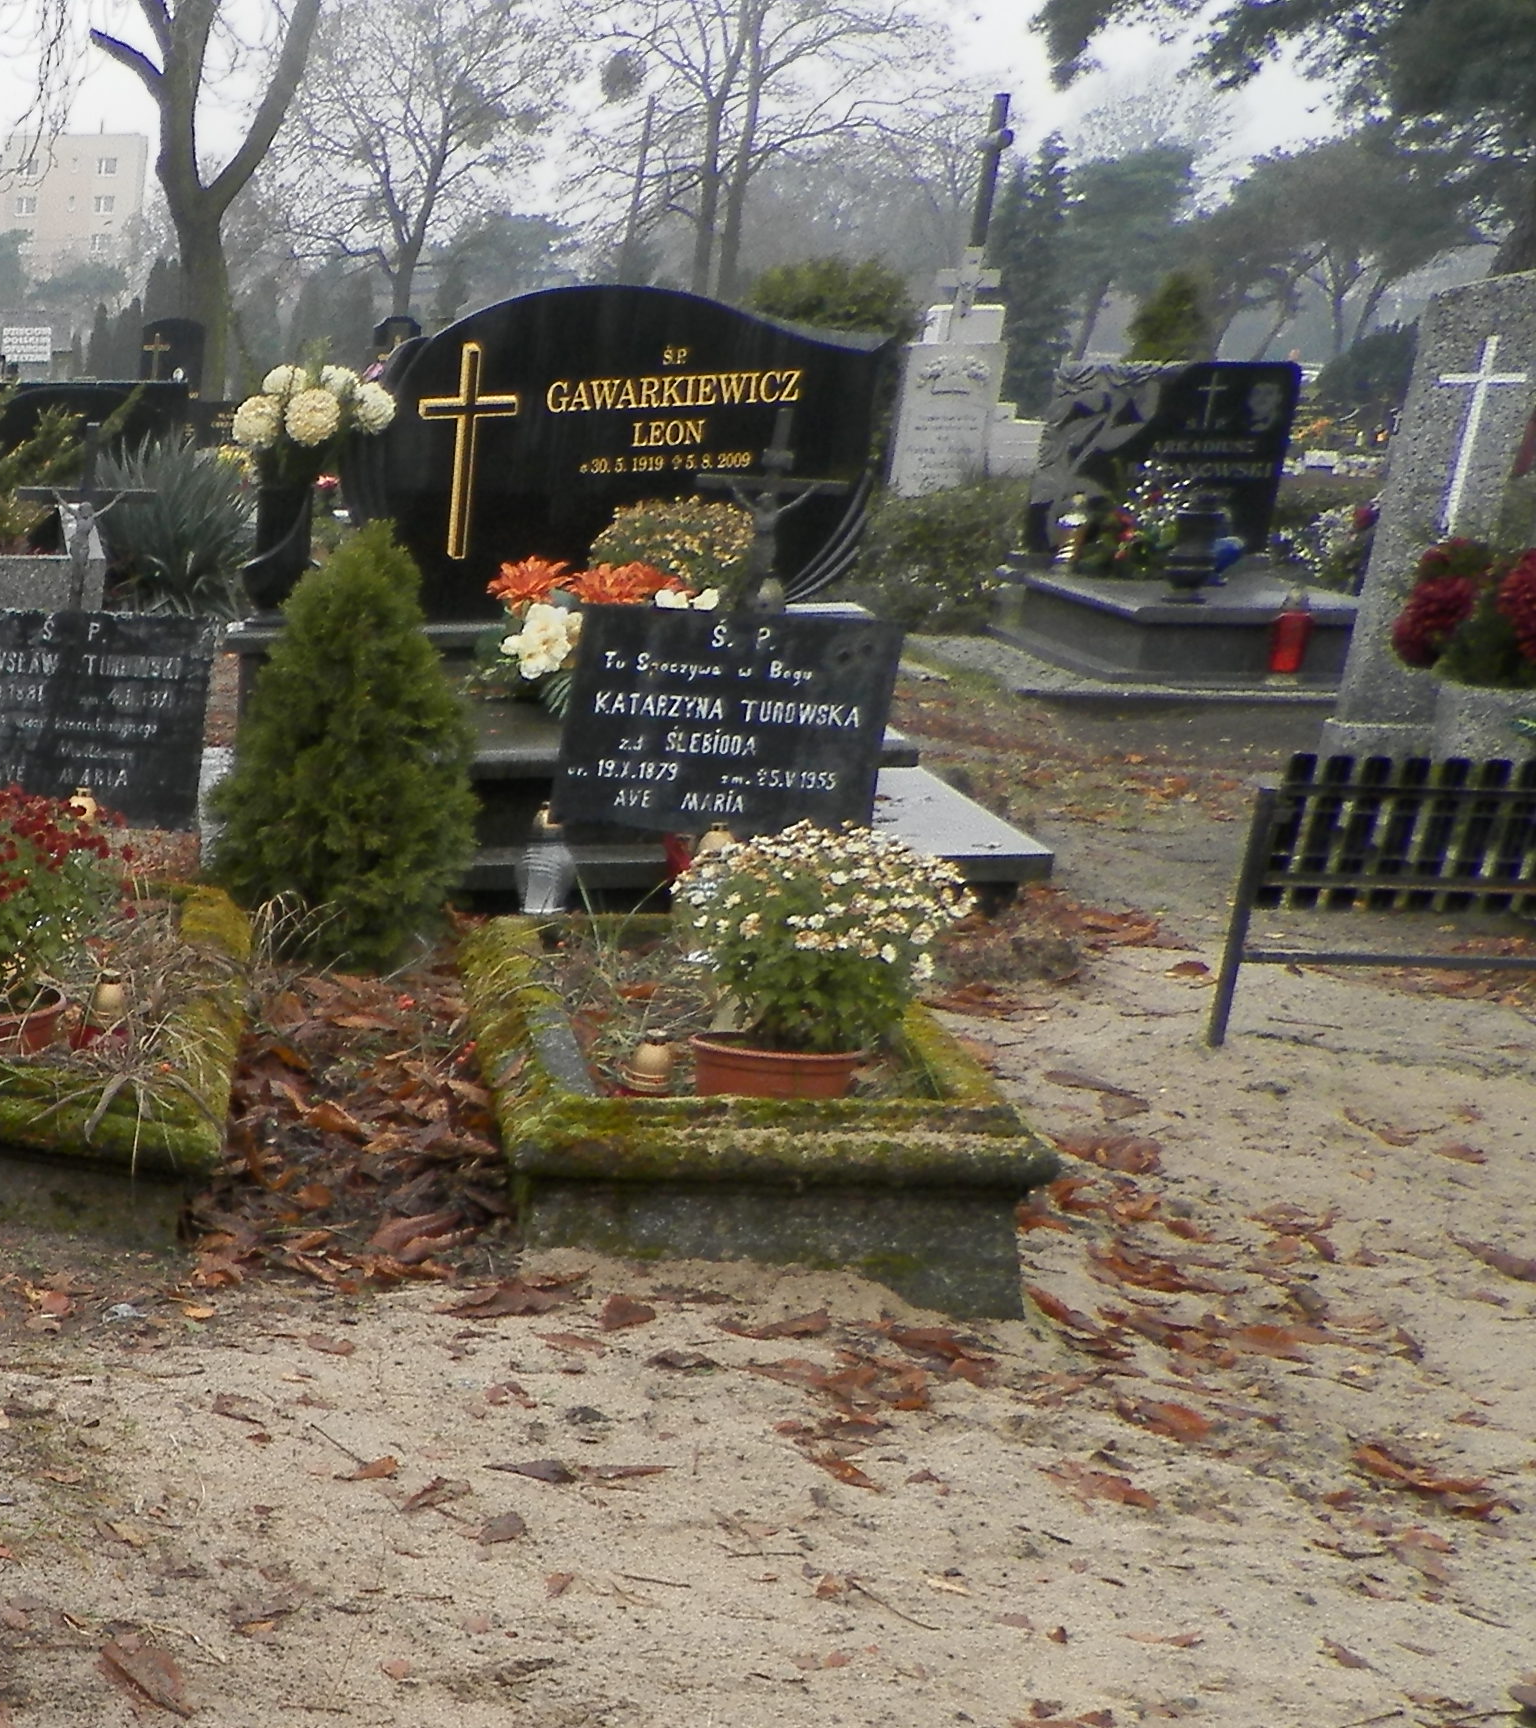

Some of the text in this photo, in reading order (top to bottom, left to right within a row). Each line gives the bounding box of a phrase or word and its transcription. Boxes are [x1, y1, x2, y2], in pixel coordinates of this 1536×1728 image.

[545, 370, 802, 414] GAWARKIEWICZ
[631, 418, 706, 448] LEON
[594, 691, 861, 728] KATARZYNA TUROWSKA
[59, 768, 128, 787] MARIA
[614, 789, 745, 813] AVE MARIA
